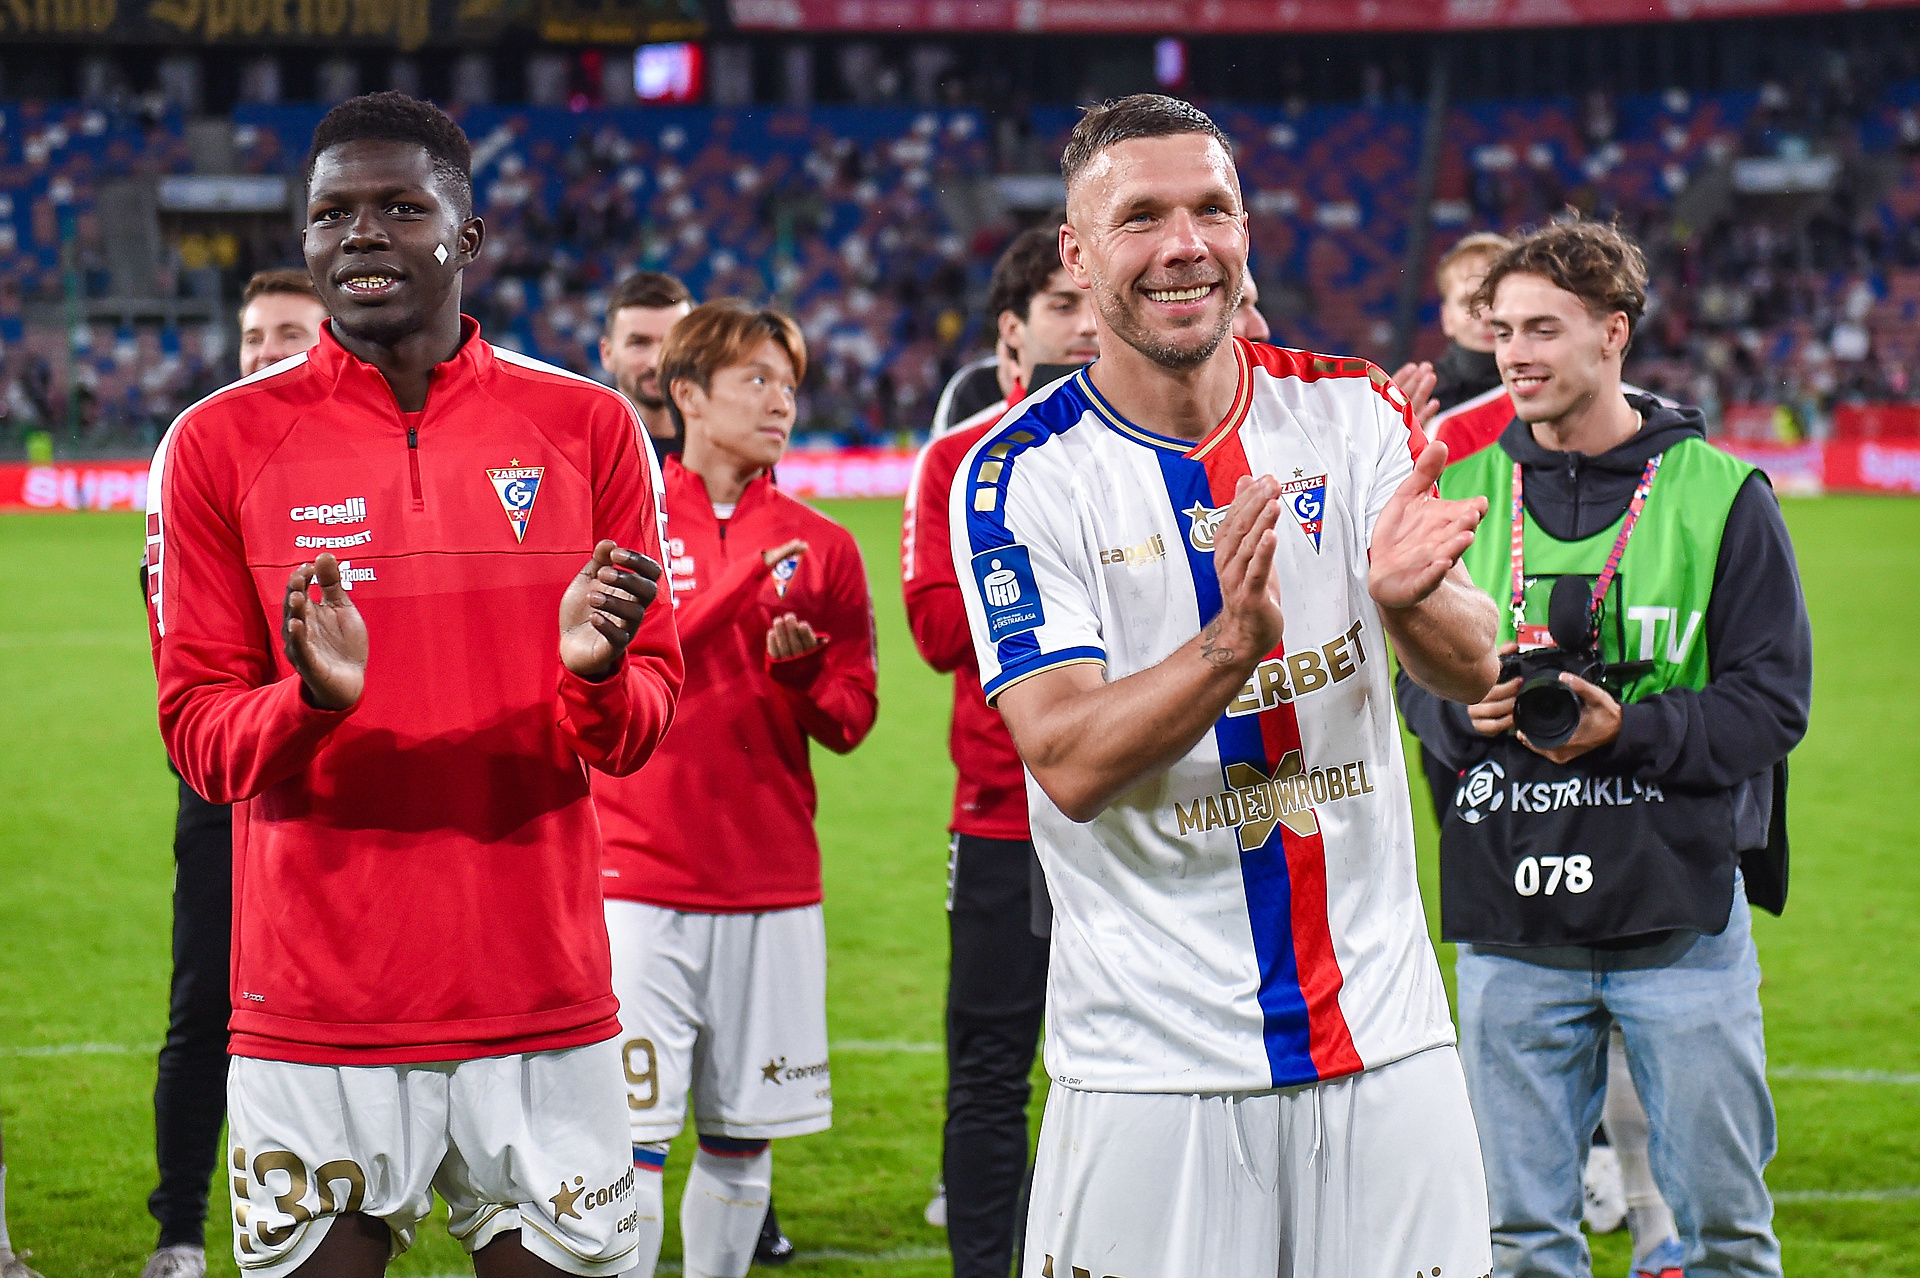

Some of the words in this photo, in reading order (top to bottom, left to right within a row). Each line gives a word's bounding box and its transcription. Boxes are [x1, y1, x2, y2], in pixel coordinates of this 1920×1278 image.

[492, 469, 540, 479] ZABRZE
[1281, 477, 1324, 494] ZABRZE
[290, 497, 366, 524] capelli
[325, 515, 366, 525] SPORT
[294, 529, 372, 549] SUPERBET
[1100, 533, 1165, 567] capelli
[1627, 606, 1701, 664] TV
[1226, 620, 1367, 715] ERBET
[1174, 785, 1272, 837] MADEJ
[1273, 761, 1374, 816] WRÓBEL
[1511, 776, 1664, 813] KSTRAKLA
[1514, 853, 1594, 897] 078
[622, 1037, 660, 1111] 9
[584, 1165, 636, 1211] corendo
